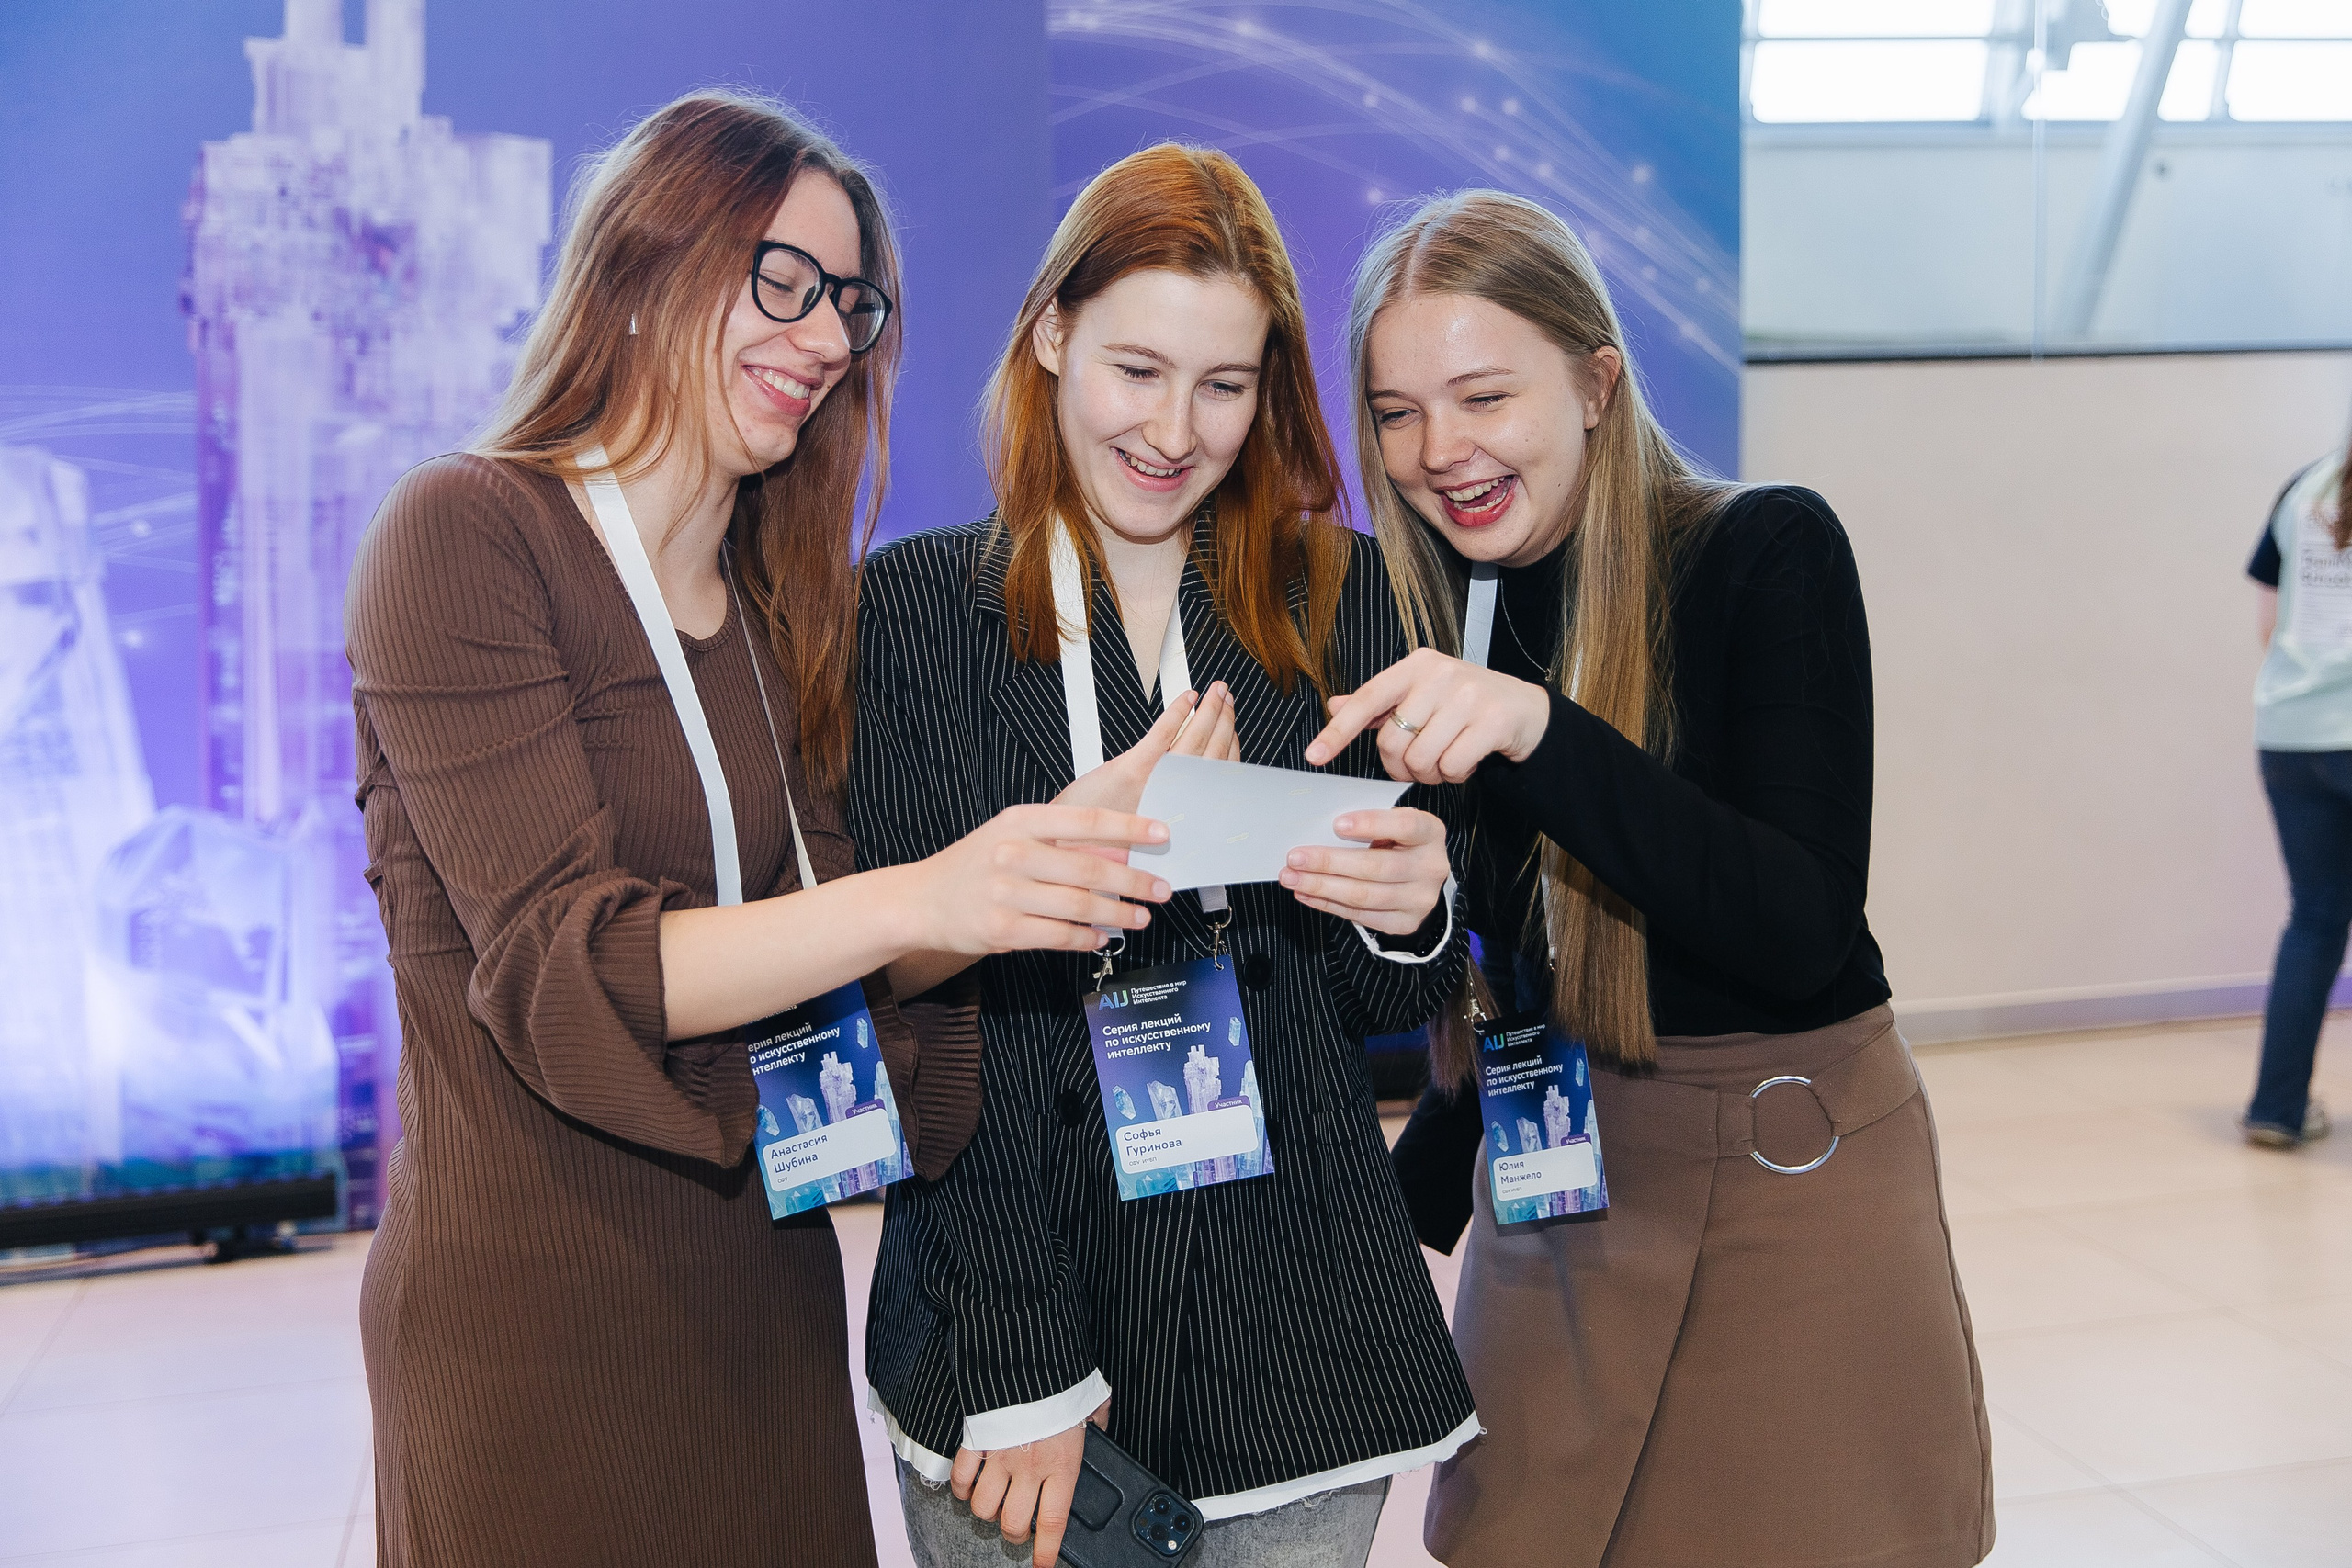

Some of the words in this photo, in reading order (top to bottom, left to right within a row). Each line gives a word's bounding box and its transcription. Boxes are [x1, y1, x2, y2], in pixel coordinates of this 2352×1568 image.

[1130, 982, 1170, 994] Путешествие
[1131, 987, 1179, 999] Искусственного
[1099, 989, 1129, 1010] AIJ
[1133, 995, 1168, 1005] Интеллекта
[1102, 1022, 1138, 1036] Серия
[1140, 1013, 1182, 1030] лекций
[1506, 1027, 1533, 1037] Путешествие
[747, 1038, 774, 1053] ерия
[775, 1021, 813, 1043] лекций
[1105, 1038, 1119, 1048] по
[1121, 1021, 1211, 1045] искусственному
[1483, 1033, 1505, 1052] AIJ
[1507, 1031, 1540, 1042] Искусственного
[1507, 1038, 1532, 1047] Интеллекта
[749, 1055, 757, 1064] о
[758, 1027, 841, 1061] искусственному
[1107, 1041, 1171, 1059] интеллекту
[752, 1052, 806, 1076] нтеллекту
[1486, 1065, 1511, 1076] Серия
[1512, 1055, 1543, 1070] лекций
[1487, 1077, 1498, 1087] по
[1498, 1063, 1564, 1084] искусственному
[1487, 1081, 1535, 1097] интеллекту
[851, 1102, 878, 1115] Участник
[1214, 1099, 1243, 1108] Участник
[1124, 1128, 1162, 1142] Софья
[771, 1134, 828, 1160] Анастасия
[1126, 1138, 1182, 1157] Гуринова
[774, 1153, 819, 1174] Шубина
[1498, 1161, 1524, 1172] Юлия
[1500, 1171, 1542, 1185] Манжело
